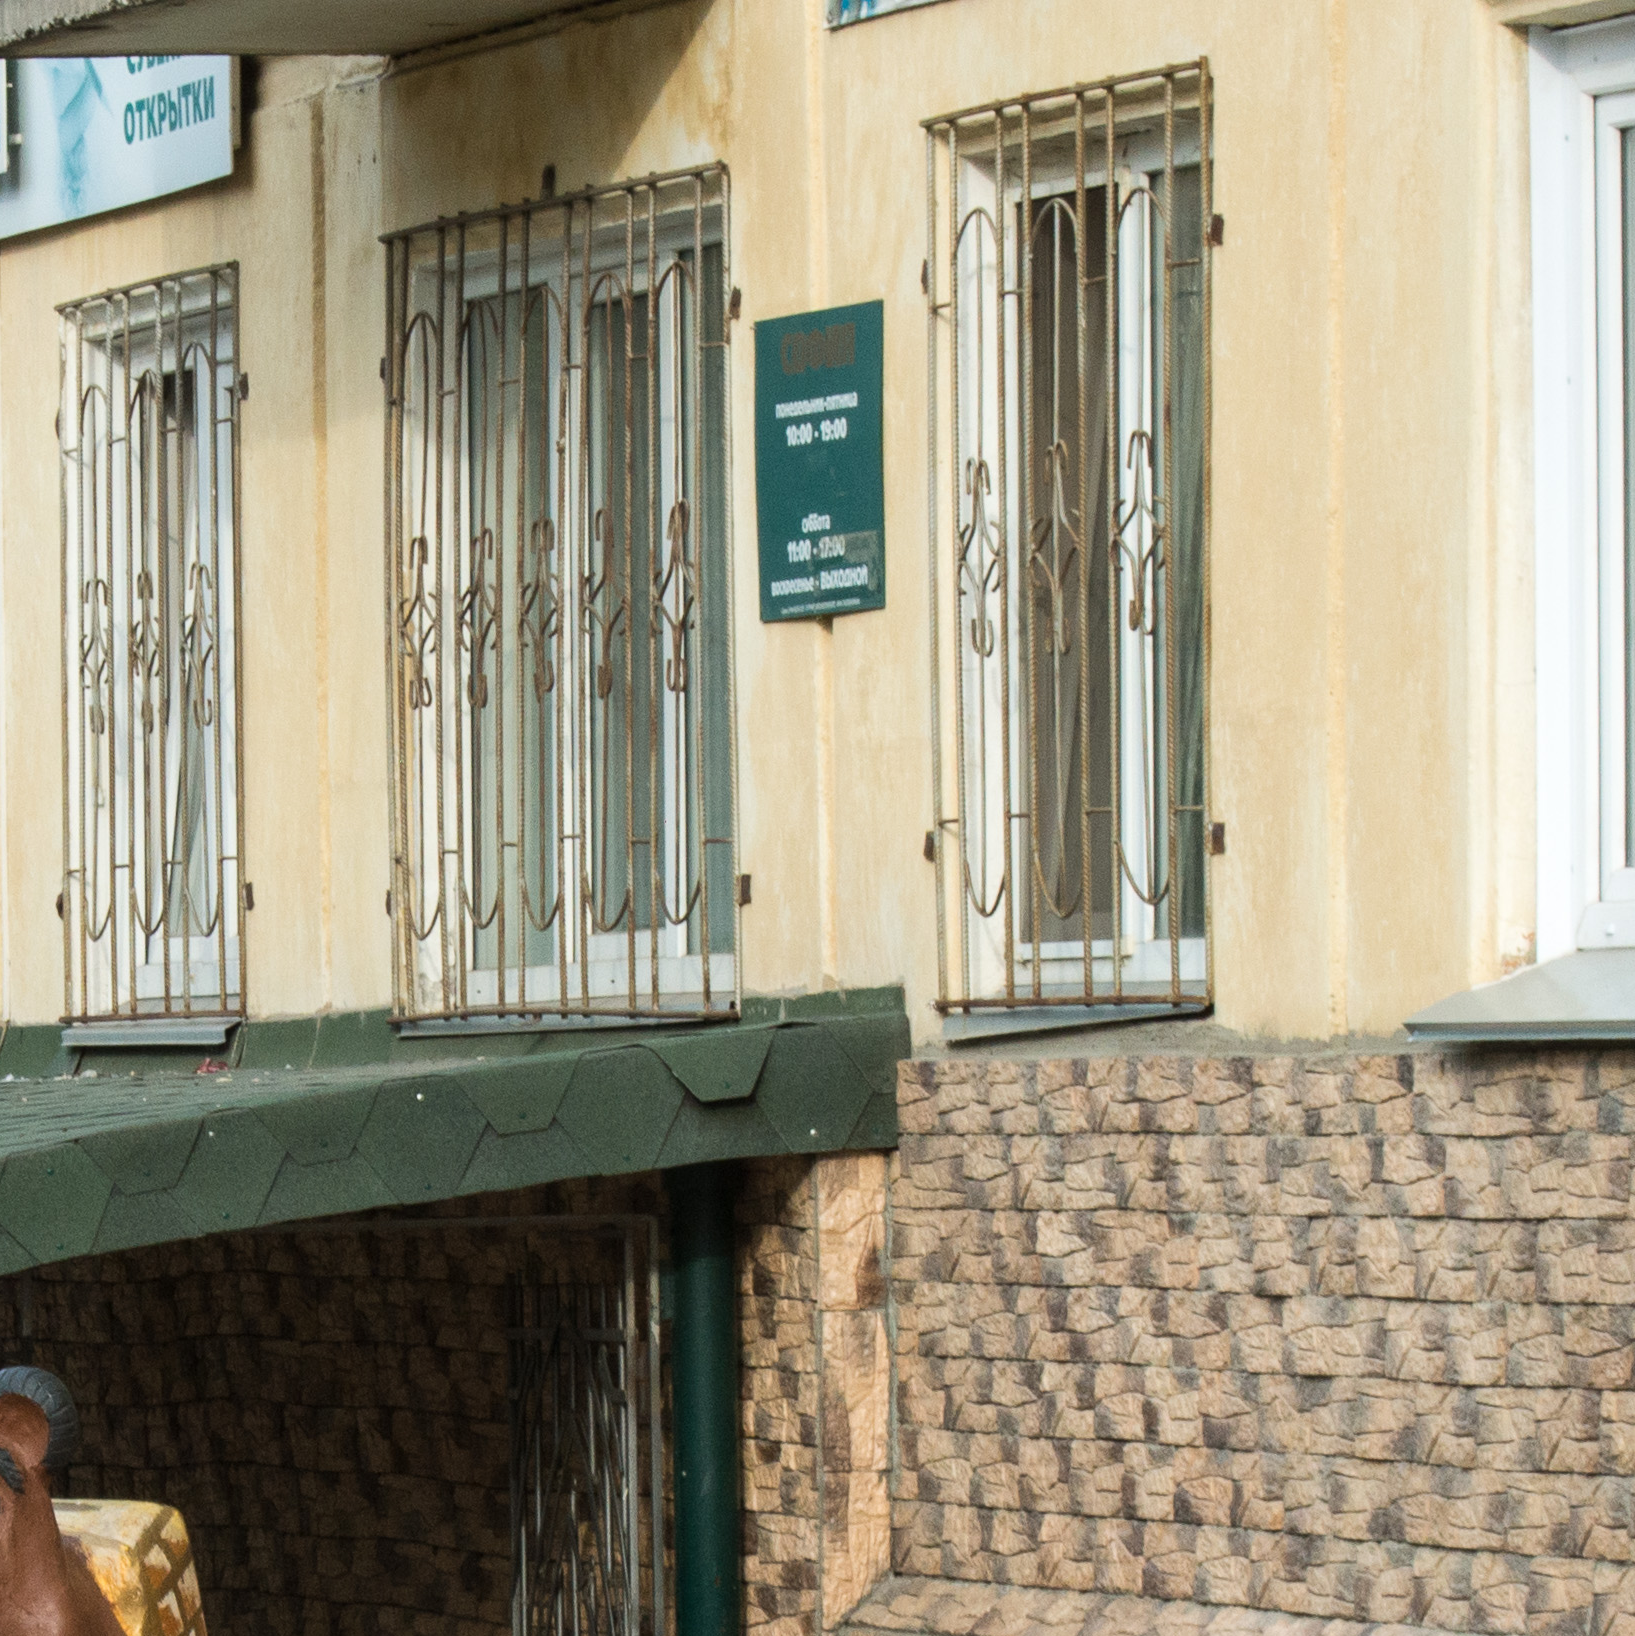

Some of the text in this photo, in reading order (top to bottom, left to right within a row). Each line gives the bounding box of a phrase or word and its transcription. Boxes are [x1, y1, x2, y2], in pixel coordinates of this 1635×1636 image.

[123, 75, 216, 145] ОТКРЫТКИ
[786, 422, 813, 447] 10:00
[820, 416, 847, 442] 19:00
[801, 512, 831, 534] суббота
[787, 538, 812, 563] 11:00
[818, 534, 846, 559] 17:00
